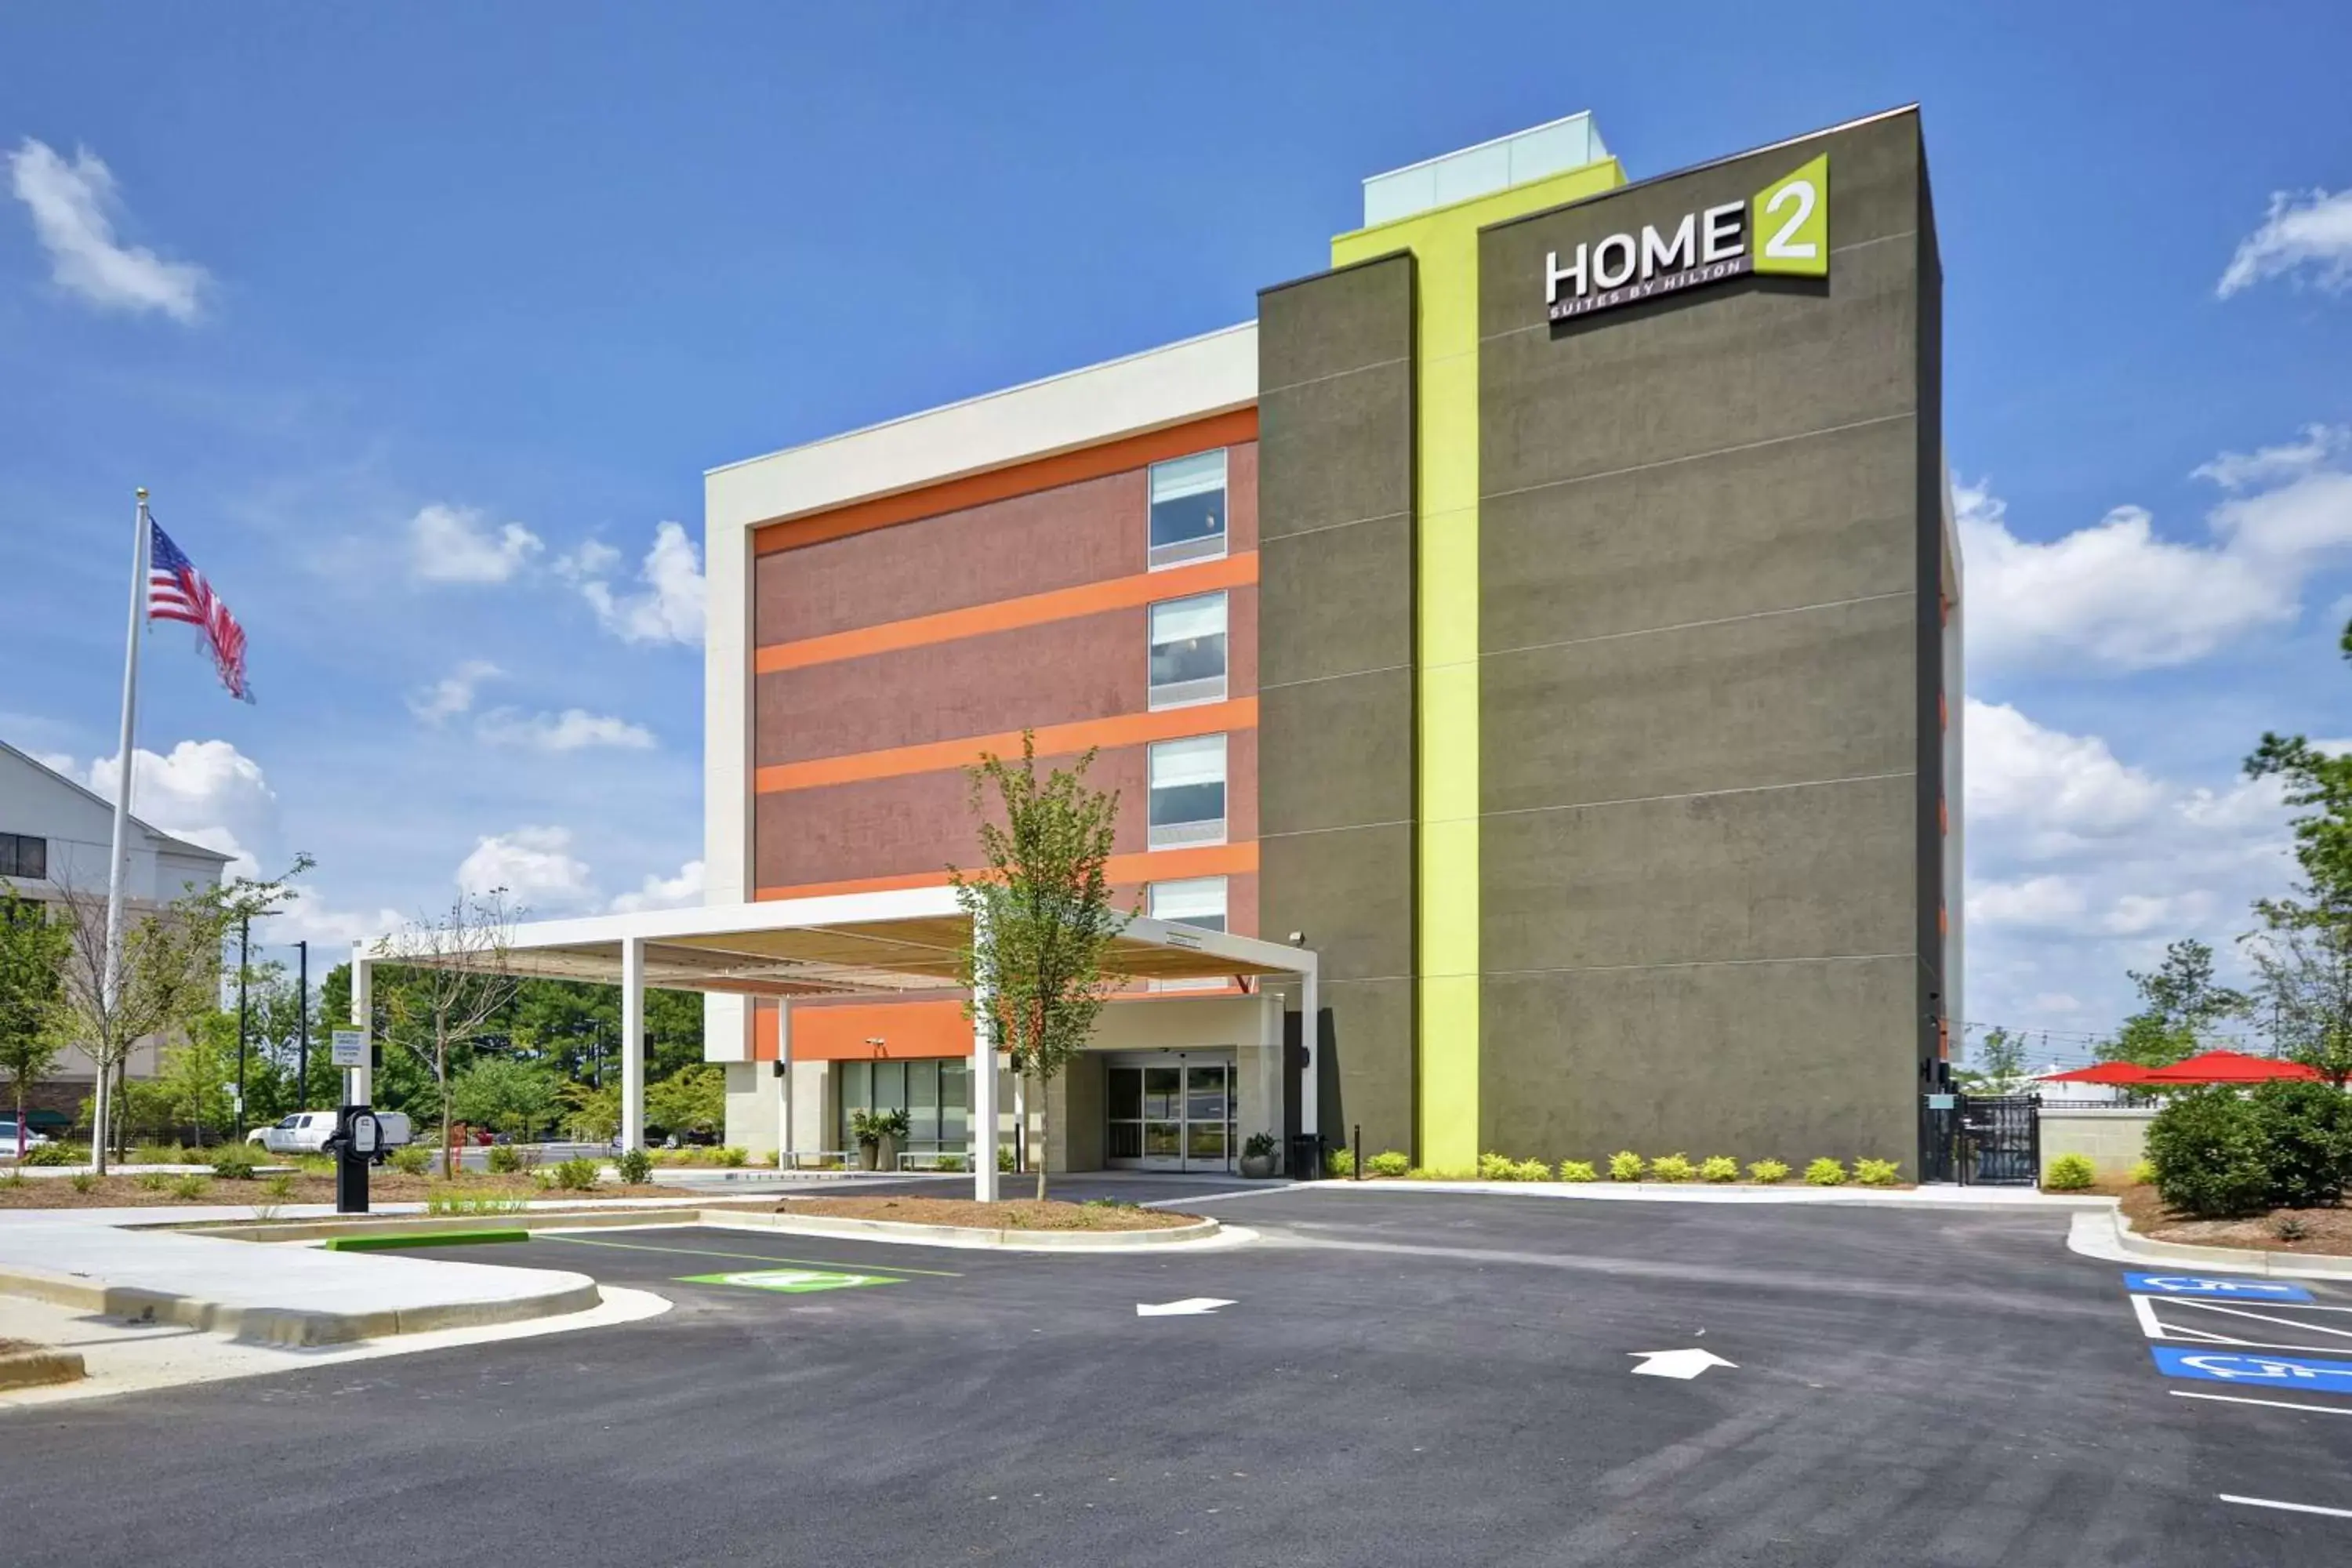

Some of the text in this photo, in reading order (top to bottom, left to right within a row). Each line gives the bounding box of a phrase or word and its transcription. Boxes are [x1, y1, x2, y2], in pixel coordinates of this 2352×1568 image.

[1546, 180, 1817, 303] HOME 2
[1550, 260, 1740, 318] SUITES BY HILTON
